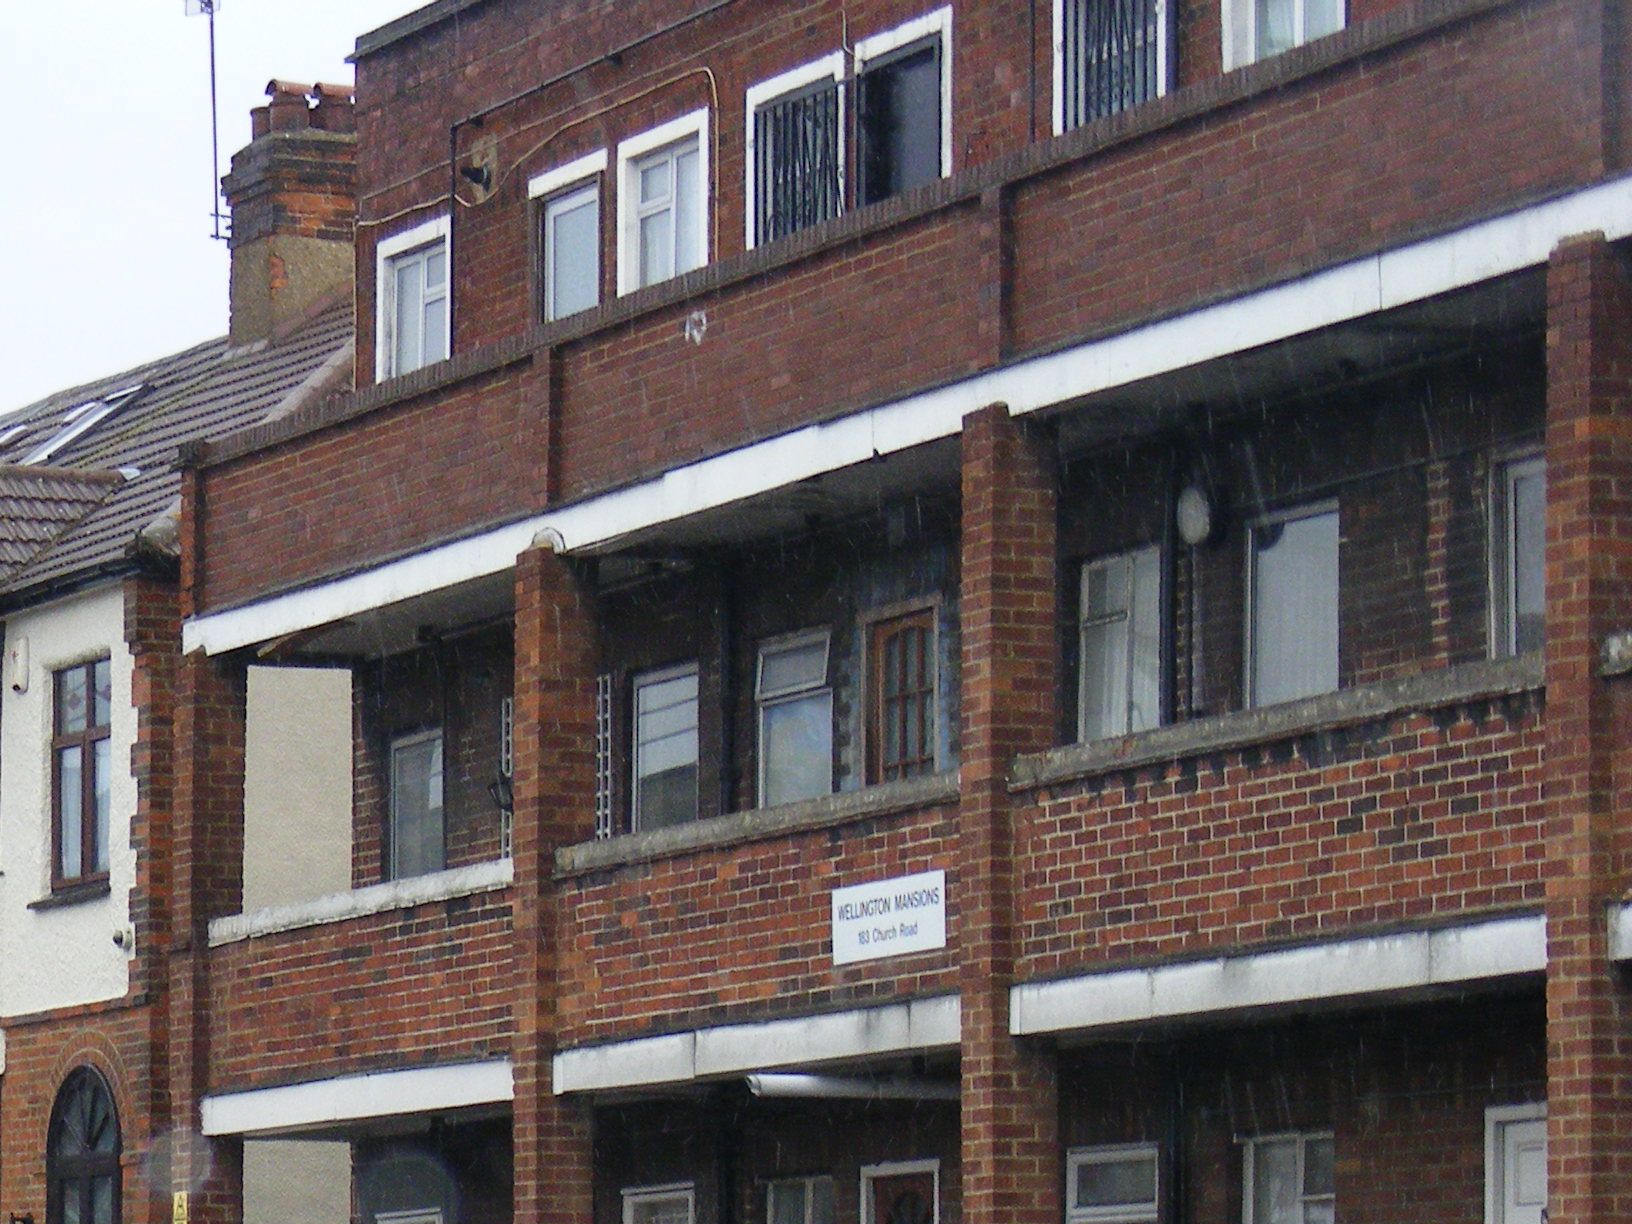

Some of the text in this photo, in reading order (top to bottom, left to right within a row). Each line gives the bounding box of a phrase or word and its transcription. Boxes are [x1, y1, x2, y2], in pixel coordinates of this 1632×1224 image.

[838, 887, 940, 920] WELLINGTON MANSIONS
[872, 924, 897, 943] Church
[899, 920, 918, 938] Road
